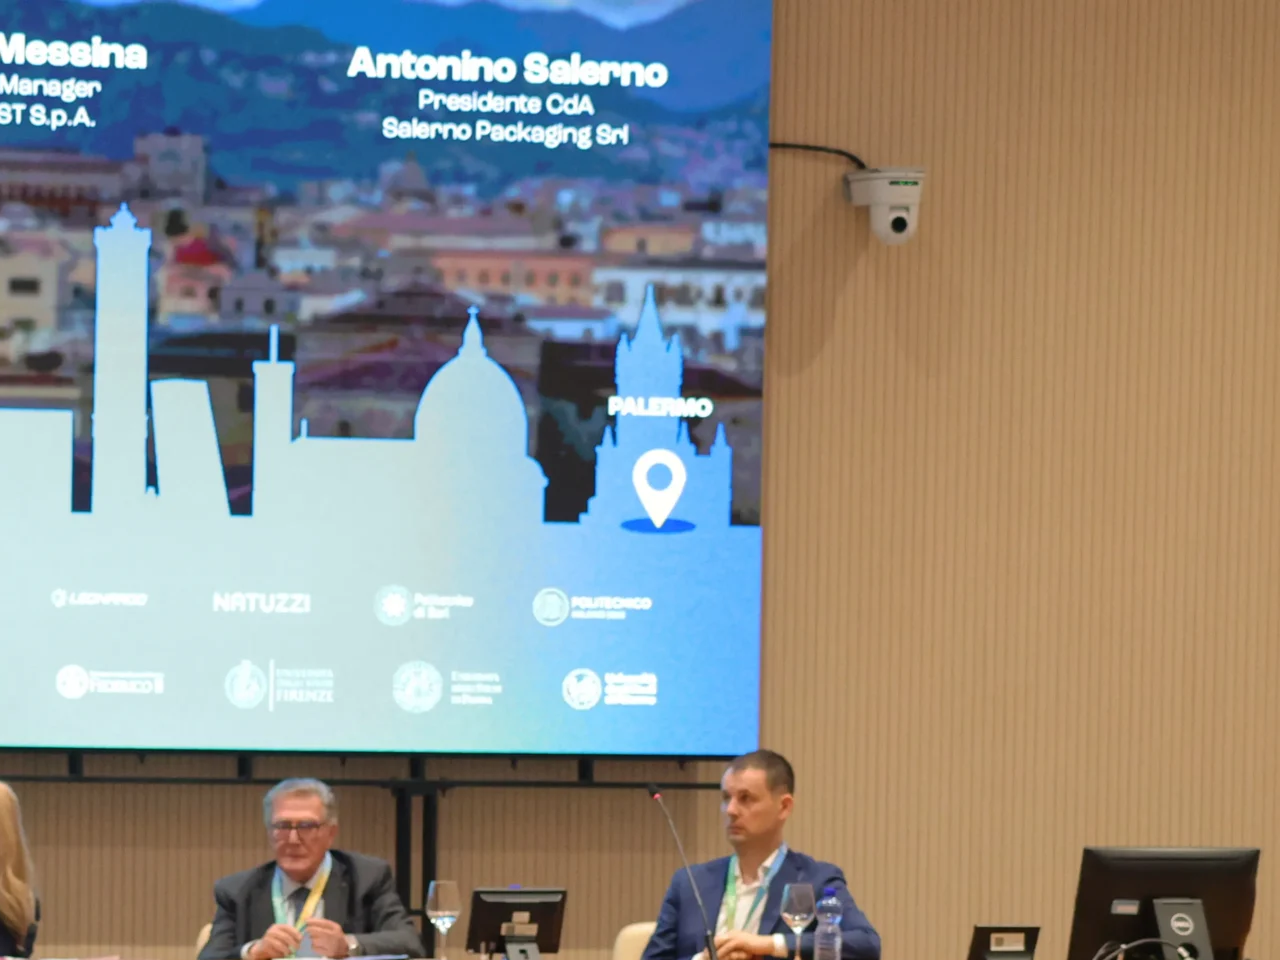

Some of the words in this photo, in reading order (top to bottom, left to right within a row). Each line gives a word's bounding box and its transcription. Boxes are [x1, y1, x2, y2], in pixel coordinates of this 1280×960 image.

[347, 46, 518, 83] Antonino
[523, 51, 669, 88] Salerno
[418, 88, 542, 115] Presidente
[545, 93, 595, 117] CdA
[29, 103, 96, 131] S.p.A.
[381, 116, 472, 140] Salerno
[475, 119, 592, 150] Packaging
[595, 123, 629, 146] Srl
[608, 396, 714, 418] PALERMO
[212, 591, 311, 614] NATUZZI
